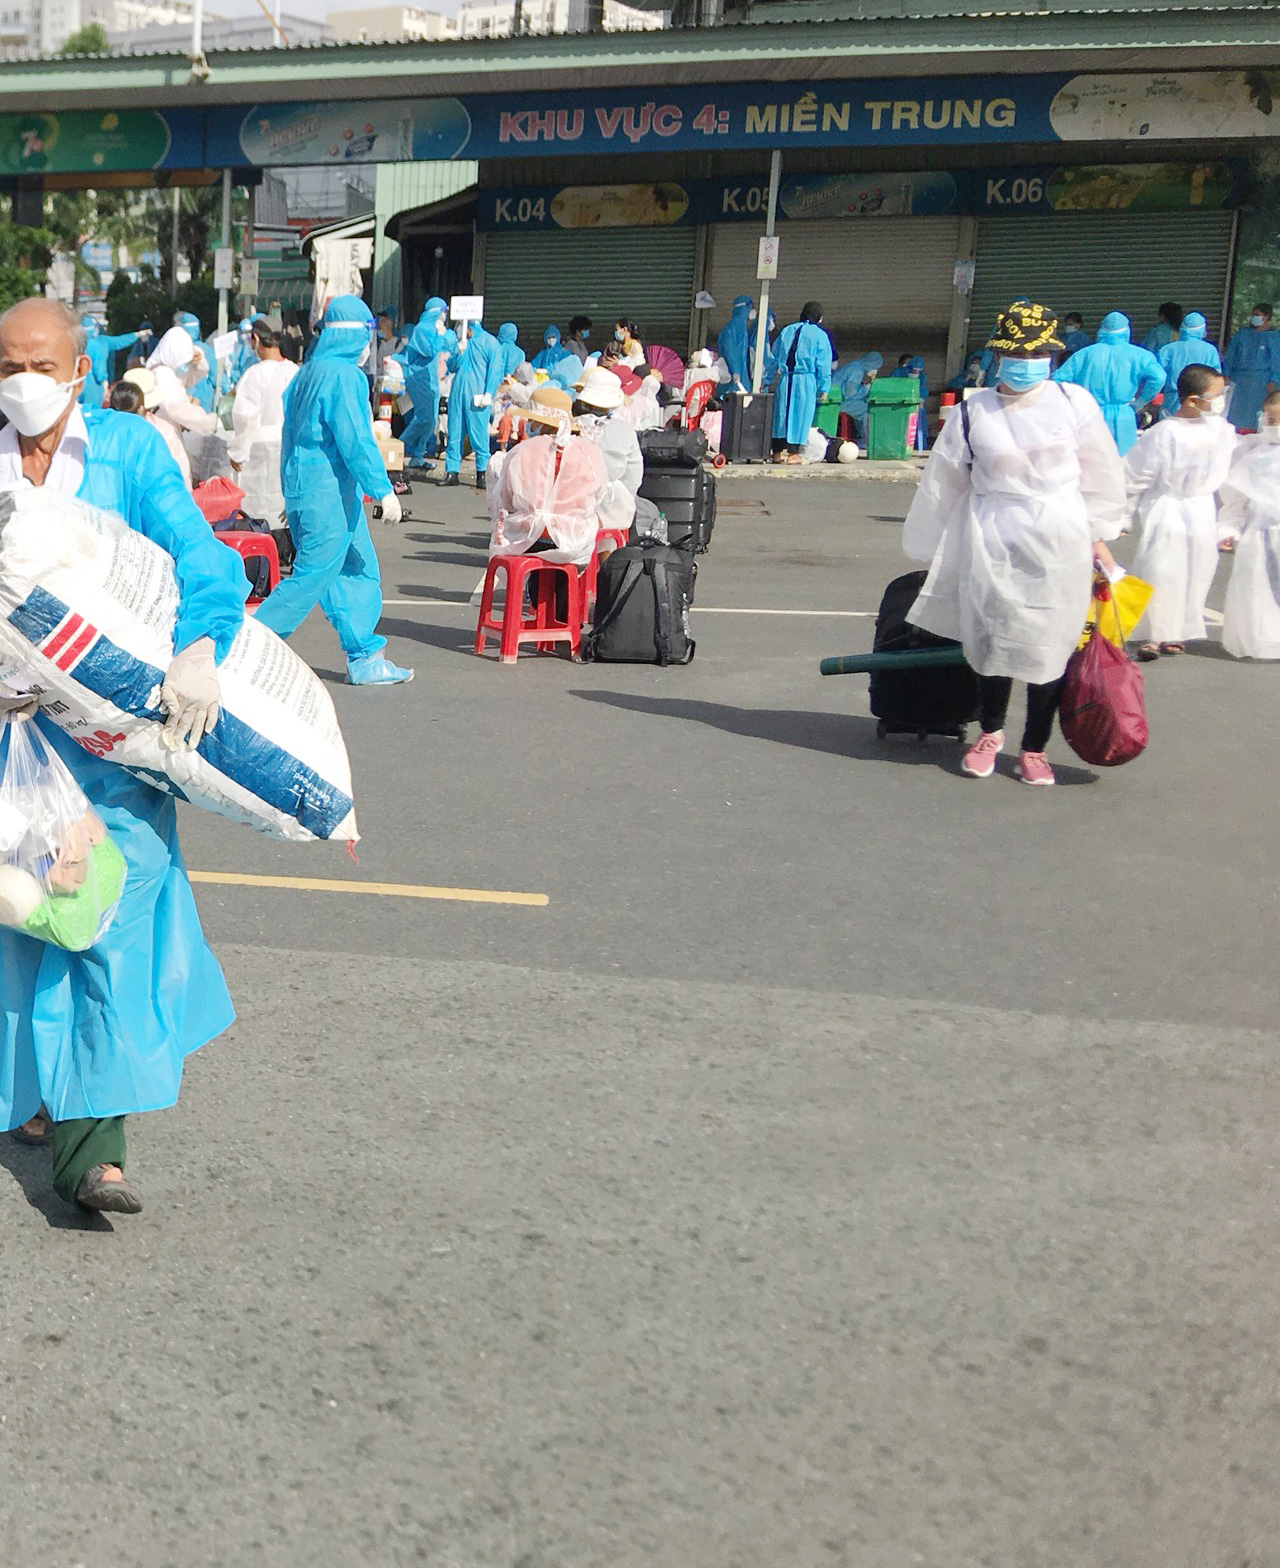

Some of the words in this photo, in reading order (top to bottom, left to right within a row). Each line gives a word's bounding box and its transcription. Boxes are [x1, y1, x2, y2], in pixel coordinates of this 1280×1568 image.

[498, 109, 584, 143] KHU
[595, 101, 683, 143] VỰC
[692, 104, 730, 134] 4:
[744, 91, 851, 134] MIỀN
[864, 98, 1017, 130] TRUNG
[985, 178, 1044, 204] K.06
[495, 197, 545, 222] K.04
